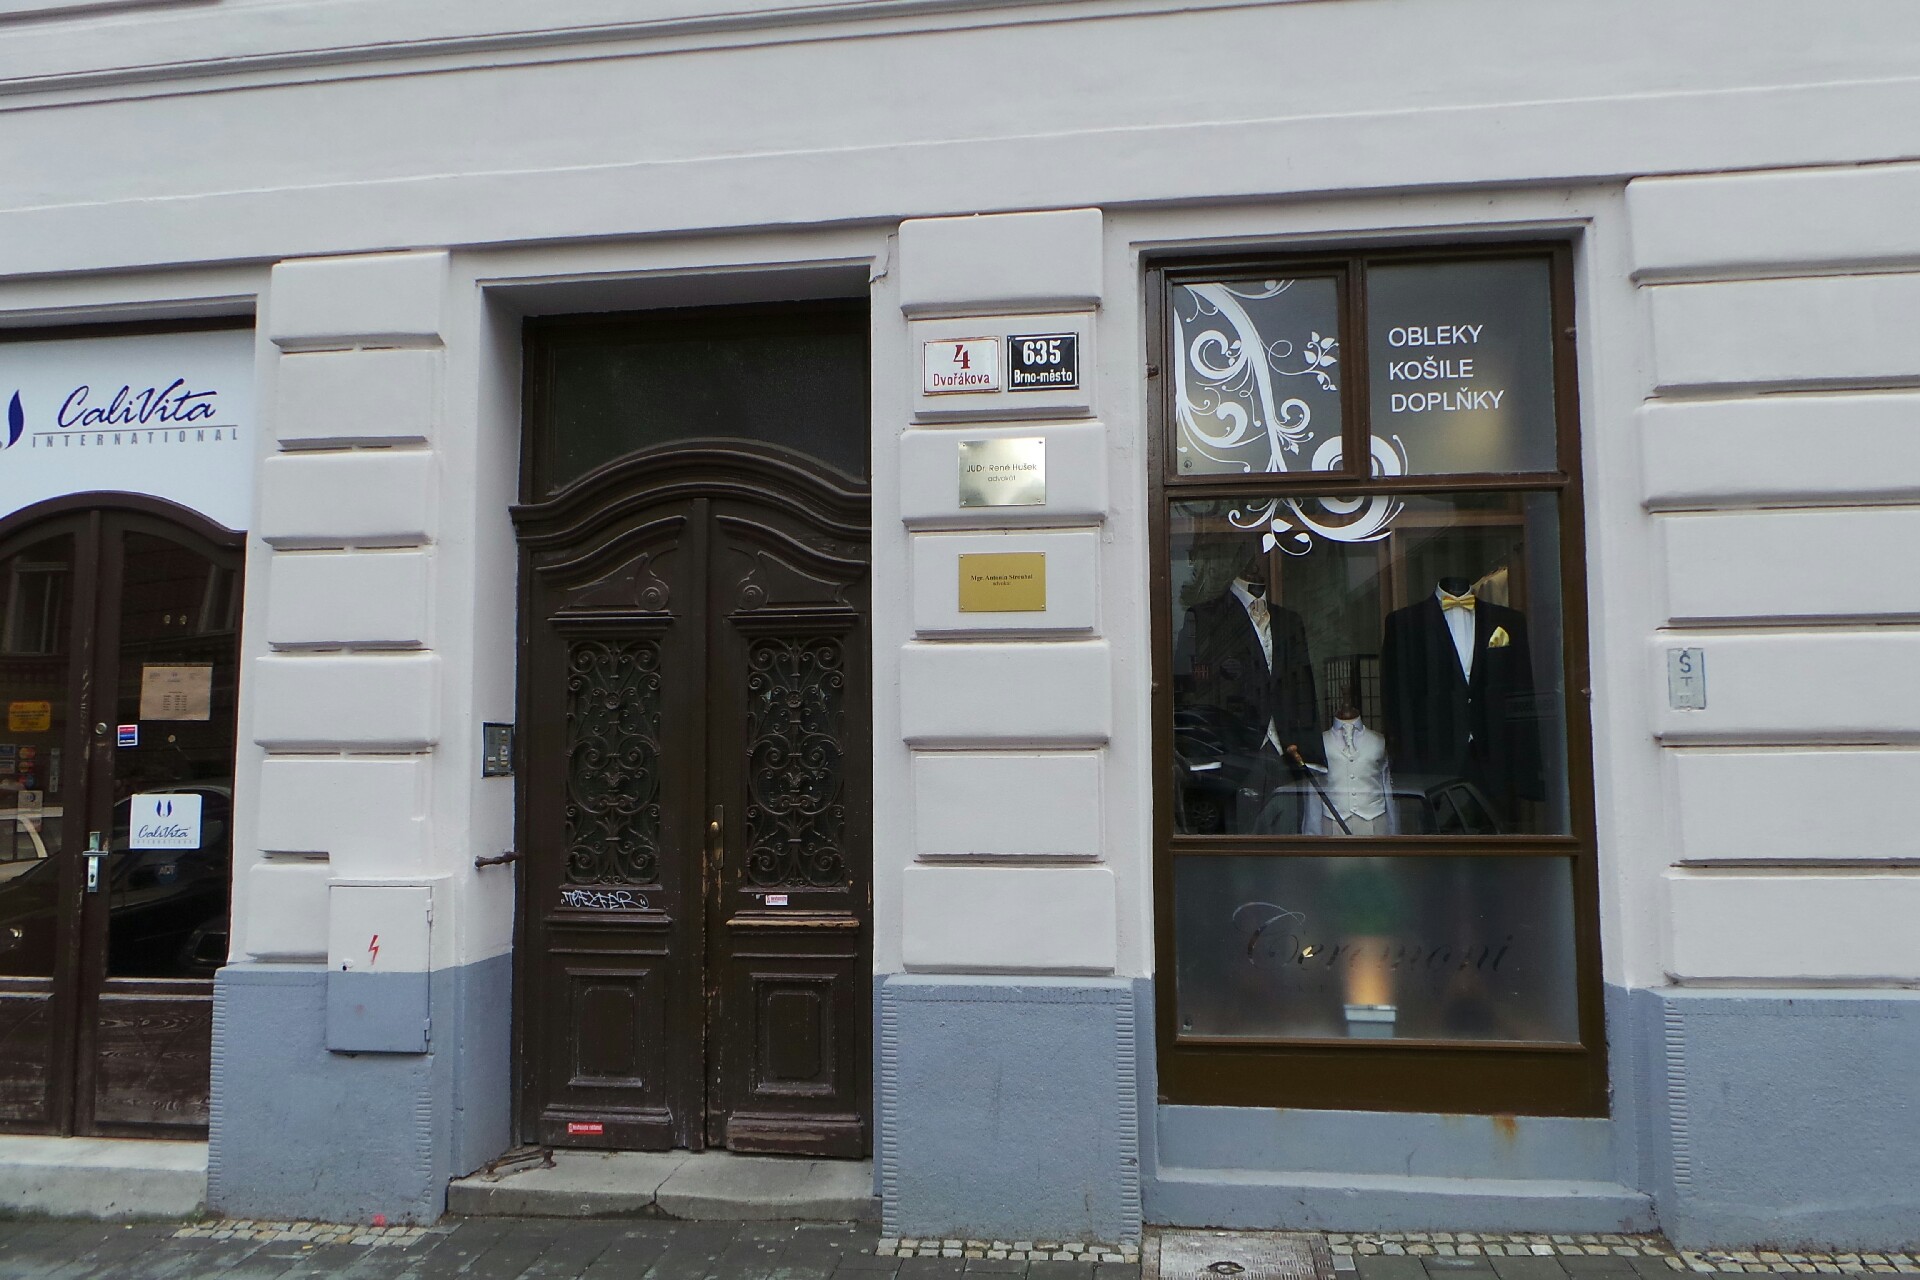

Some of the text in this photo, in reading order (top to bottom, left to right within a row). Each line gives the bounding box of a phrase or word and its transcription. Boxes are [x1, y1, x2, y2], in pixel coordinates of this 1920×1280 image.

[1388, 324, 1483, 347] OBLEKY
[953, 344, 971, 369] 4
[1022, 339, 1061, 366] 635
[1014, 367, 1072, 384] Brno-město
[1389, 354, 1474, 380] KOŠILE
[933, 373, 990, 386] Dvořákova
[57, 378, 217, 428] CaliVita
[1391, 386, 1504, 412] DOPLŇKY
[32, 428, 238, 448] INTERNATIONAL
[966, 464, 986, 473] JUDr.
[138, 823, 189, 839] CaliVita
